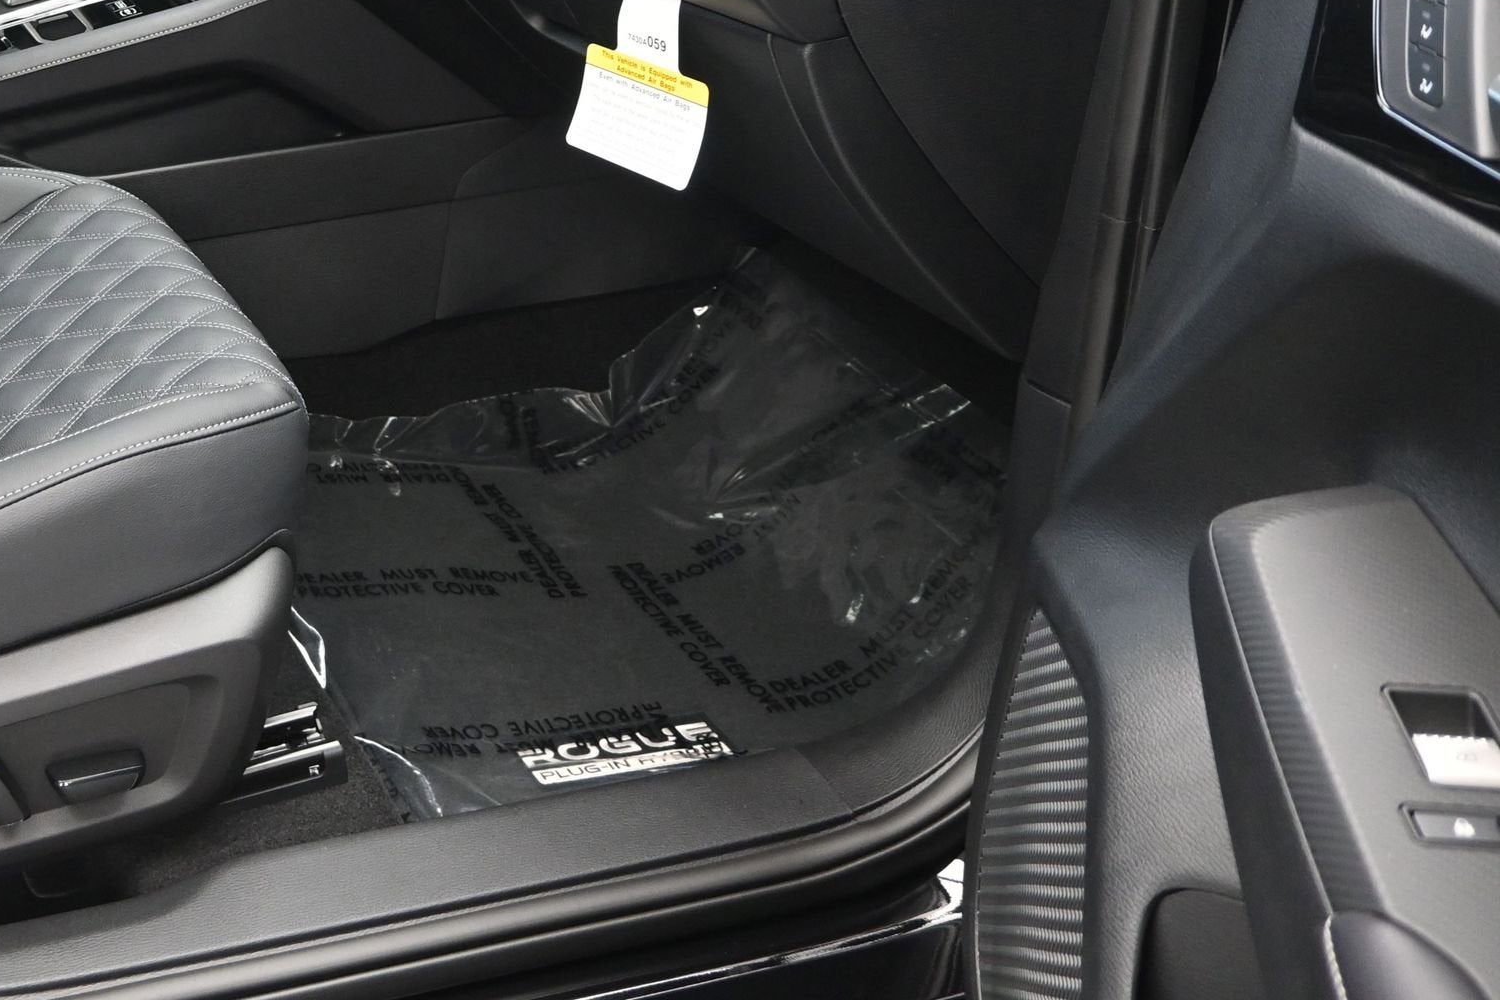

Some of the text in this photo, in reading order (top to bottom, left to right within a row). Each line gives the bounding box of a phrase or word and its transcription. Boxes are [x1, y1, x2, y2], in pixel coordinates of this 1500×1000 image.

[617, 55, 638, 69] Vehicle
[649, 67, 677, 84] Equipped
[617, 64, 645, 81] Advanced
[481, 483, 523, 519] COVER
[482, 512, 521, 543] MUST
[380, 568, 438, 581] MUST
[449, 567, 535, 584] REMOVE
[516, 523, 589, 598] PROTECTIVE
[517, 549, 566, 599] DEALER
[660, 542, 746, 585] REMOVE
[299, 581, 501, 599] PROTECTIVE COVER
[626, 561, 680, 607] DEALER
[677, 613, 724, 650] MUST
[606, 564, 685, 638] PROTECTIVE
[679, 641, 731, 687] COVER
[785, 575, 974, 712] PROTECTIVE COVER
[768, 659, 852, 695] DEALER
[858, 608, 914, 659] MUST
[422, 723, 499, 740] COVER
[507, 704, 643, 737] PROTECTIVE
[516, 721, 719, 769] ROGUE
[540, 758, 630, 781] PLUG-IN
